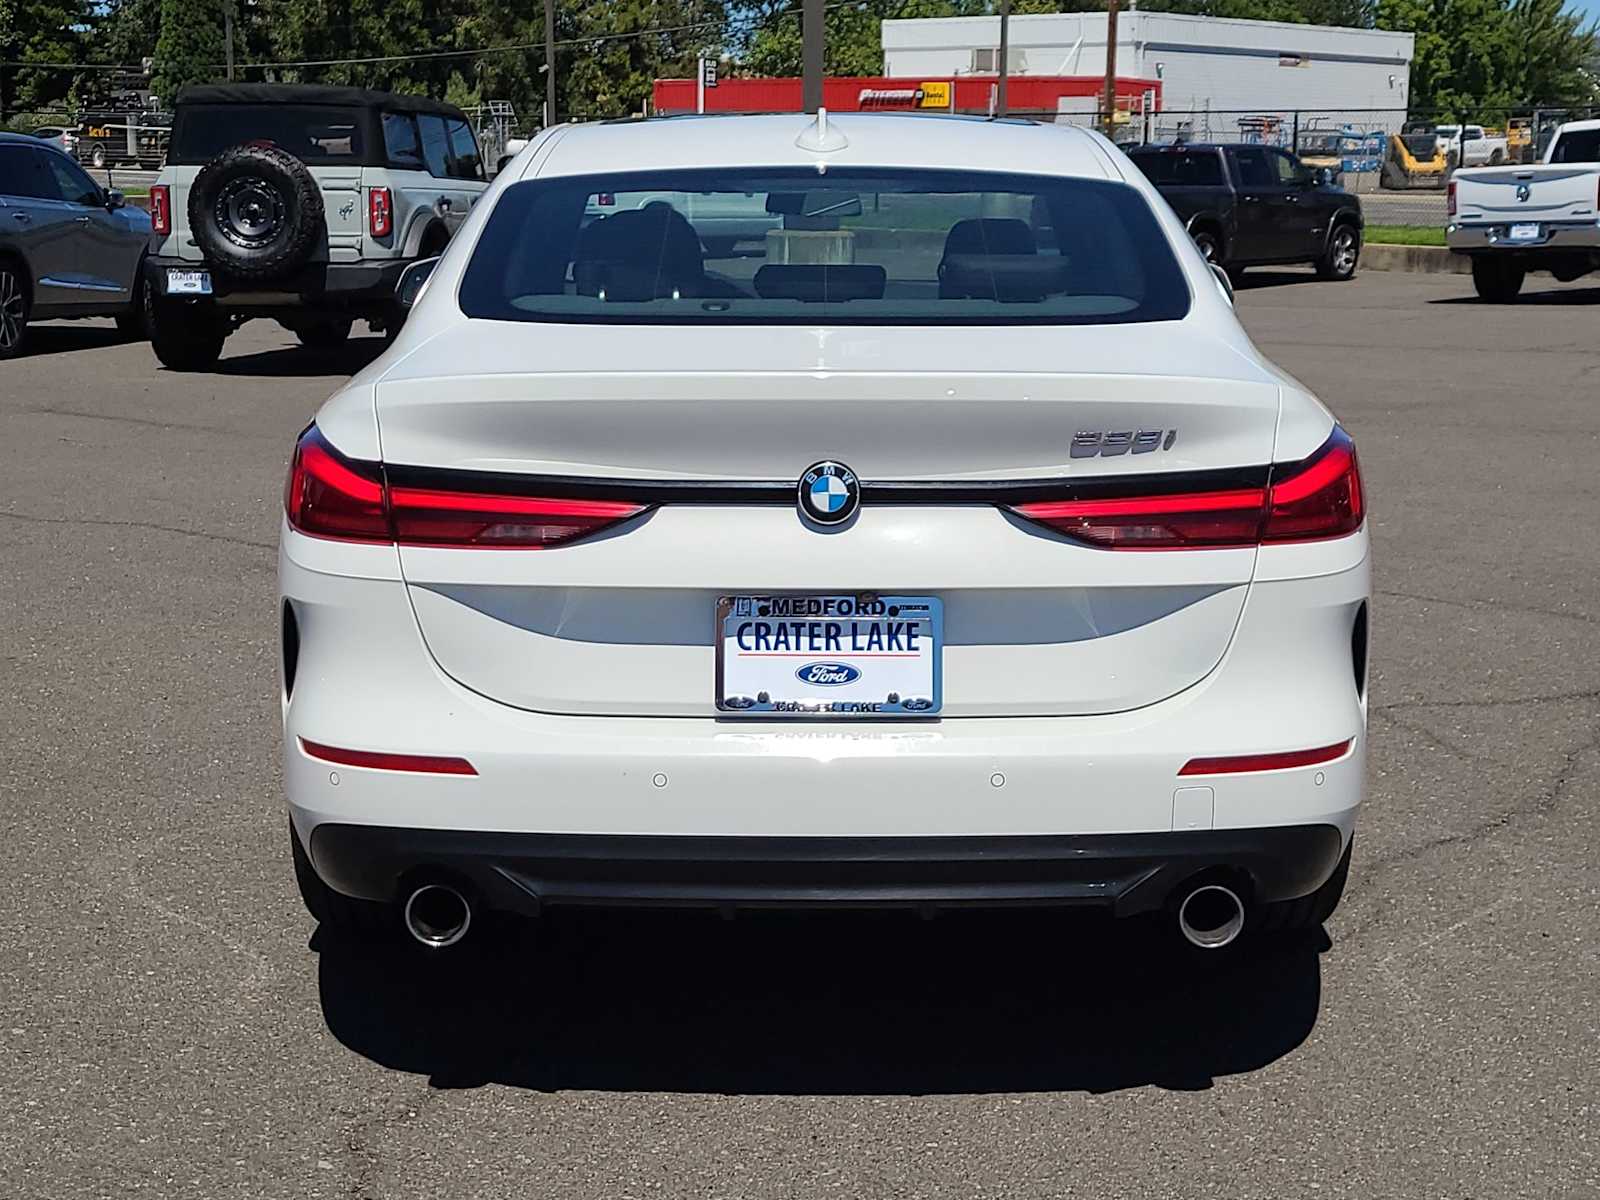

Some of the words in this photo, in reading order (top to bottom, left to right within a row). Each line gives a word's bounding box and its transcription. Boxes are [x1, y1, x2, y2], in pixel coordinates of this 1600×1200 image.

[806, 466, 854, 485] BMW
[771, 598, 887, 617] MEDFORD
[737, 621, 842, 652] CRATER
[852, 622, 920, 652] LAKE
[807, 664, 848, 683] Ford
